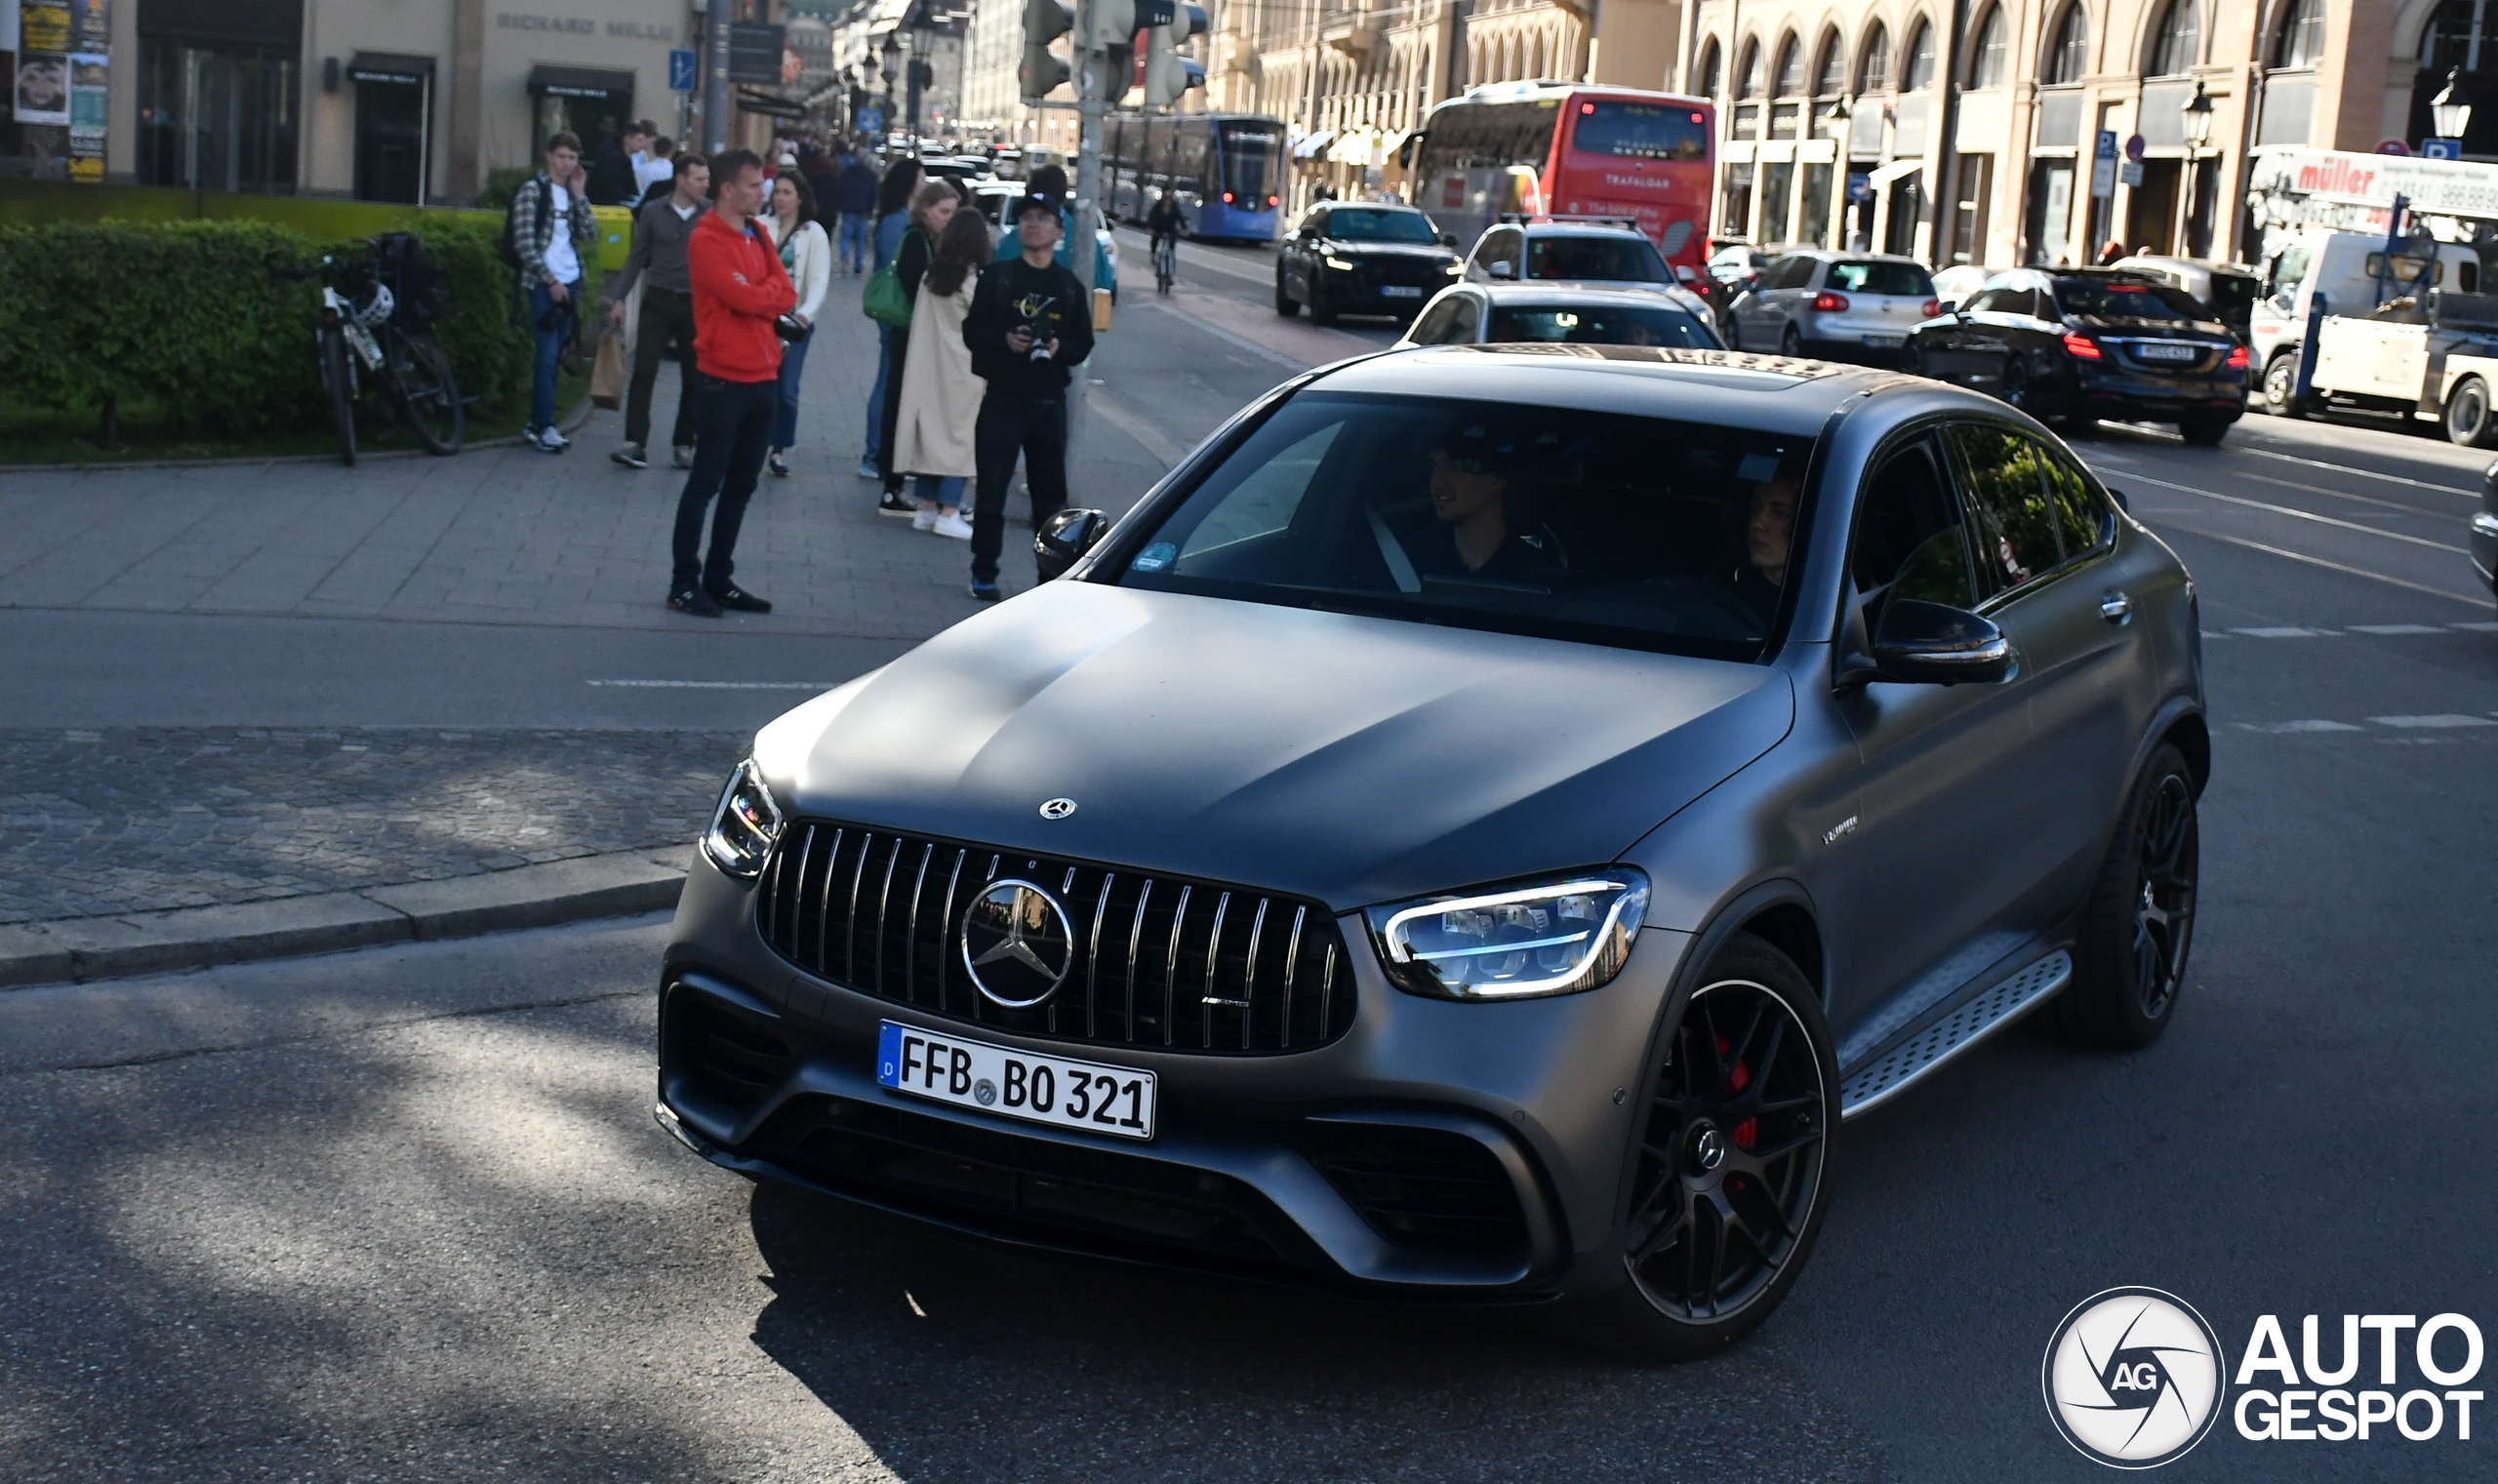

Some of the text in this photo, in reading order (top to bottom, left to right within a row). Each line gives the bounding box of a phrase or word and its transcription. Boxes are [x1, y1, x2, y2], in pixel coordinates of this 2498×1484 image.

[497, 12, 595, 35] RICHARD
[1605, 174, 1671, 190] TRAFALGAR
[2299, 155, 2376, 195] müller
[1217, 998, 1250, 1008] AMG
[883, 1062, 894, 1076] D
[902, 1035, 1145, 1129] FFB BO 321
